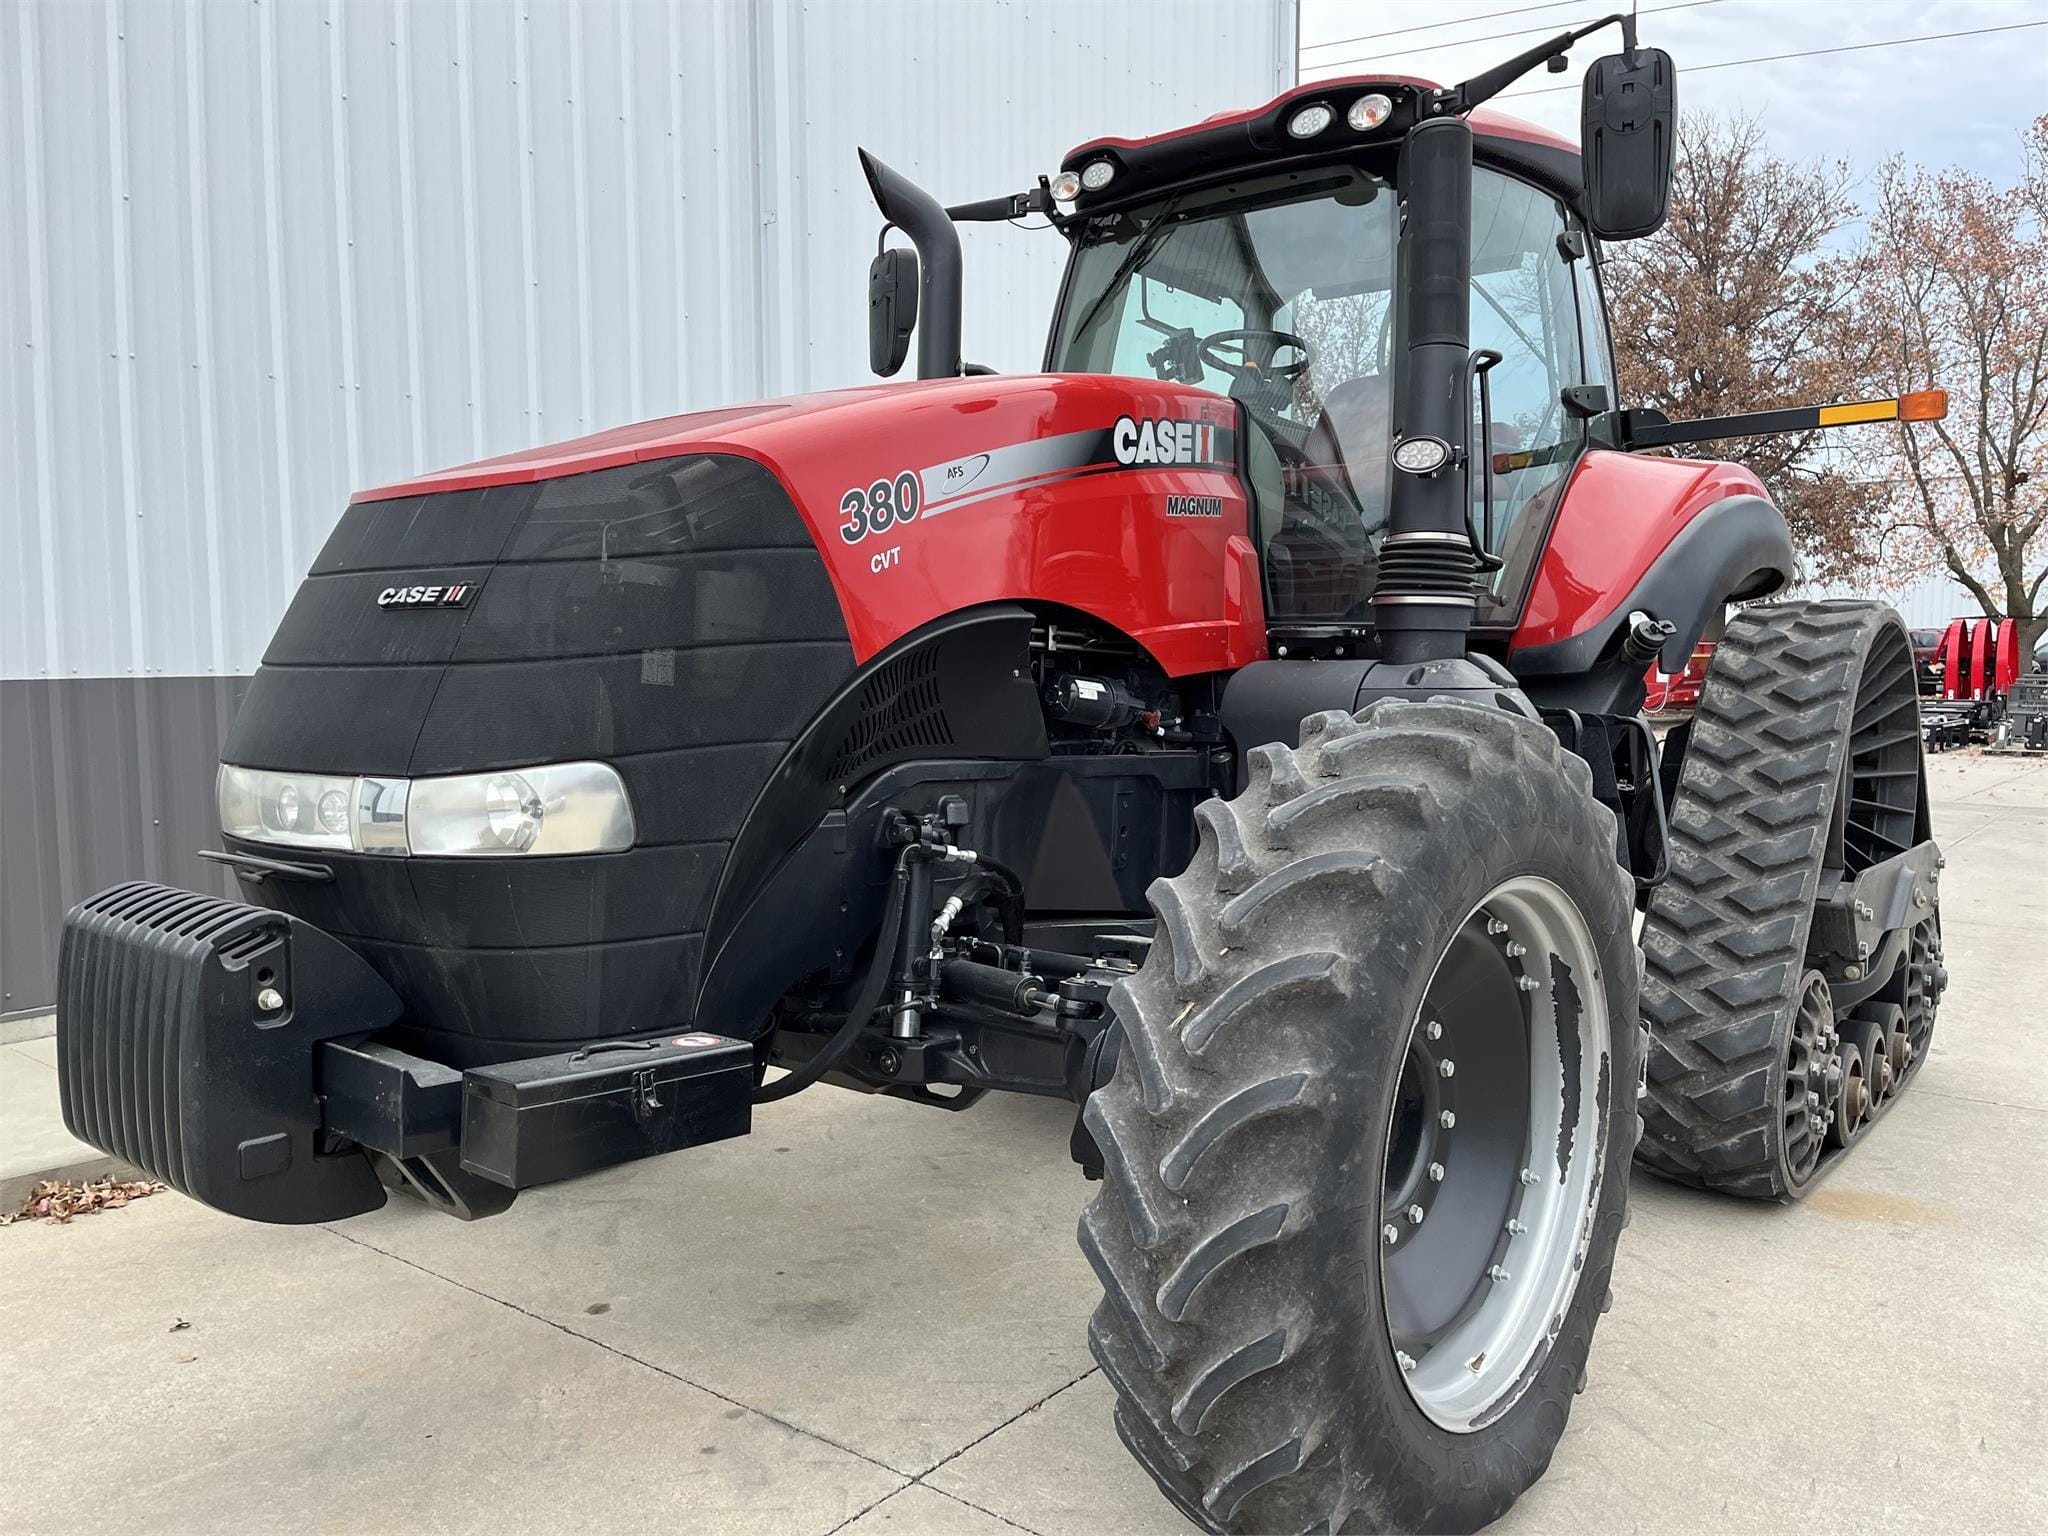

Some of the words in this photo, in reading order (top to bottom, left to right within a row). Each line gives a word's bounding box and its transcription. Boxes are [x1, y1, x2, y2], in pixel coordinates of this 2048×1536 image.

[947, 466, 965, 480] AFS
[840, 470, 920, 545] 380
[1166, 495, 1223, 517] MAGNUM
[871, 546, 901, 573] CVT
[377, 586, 443, 605] CASE
